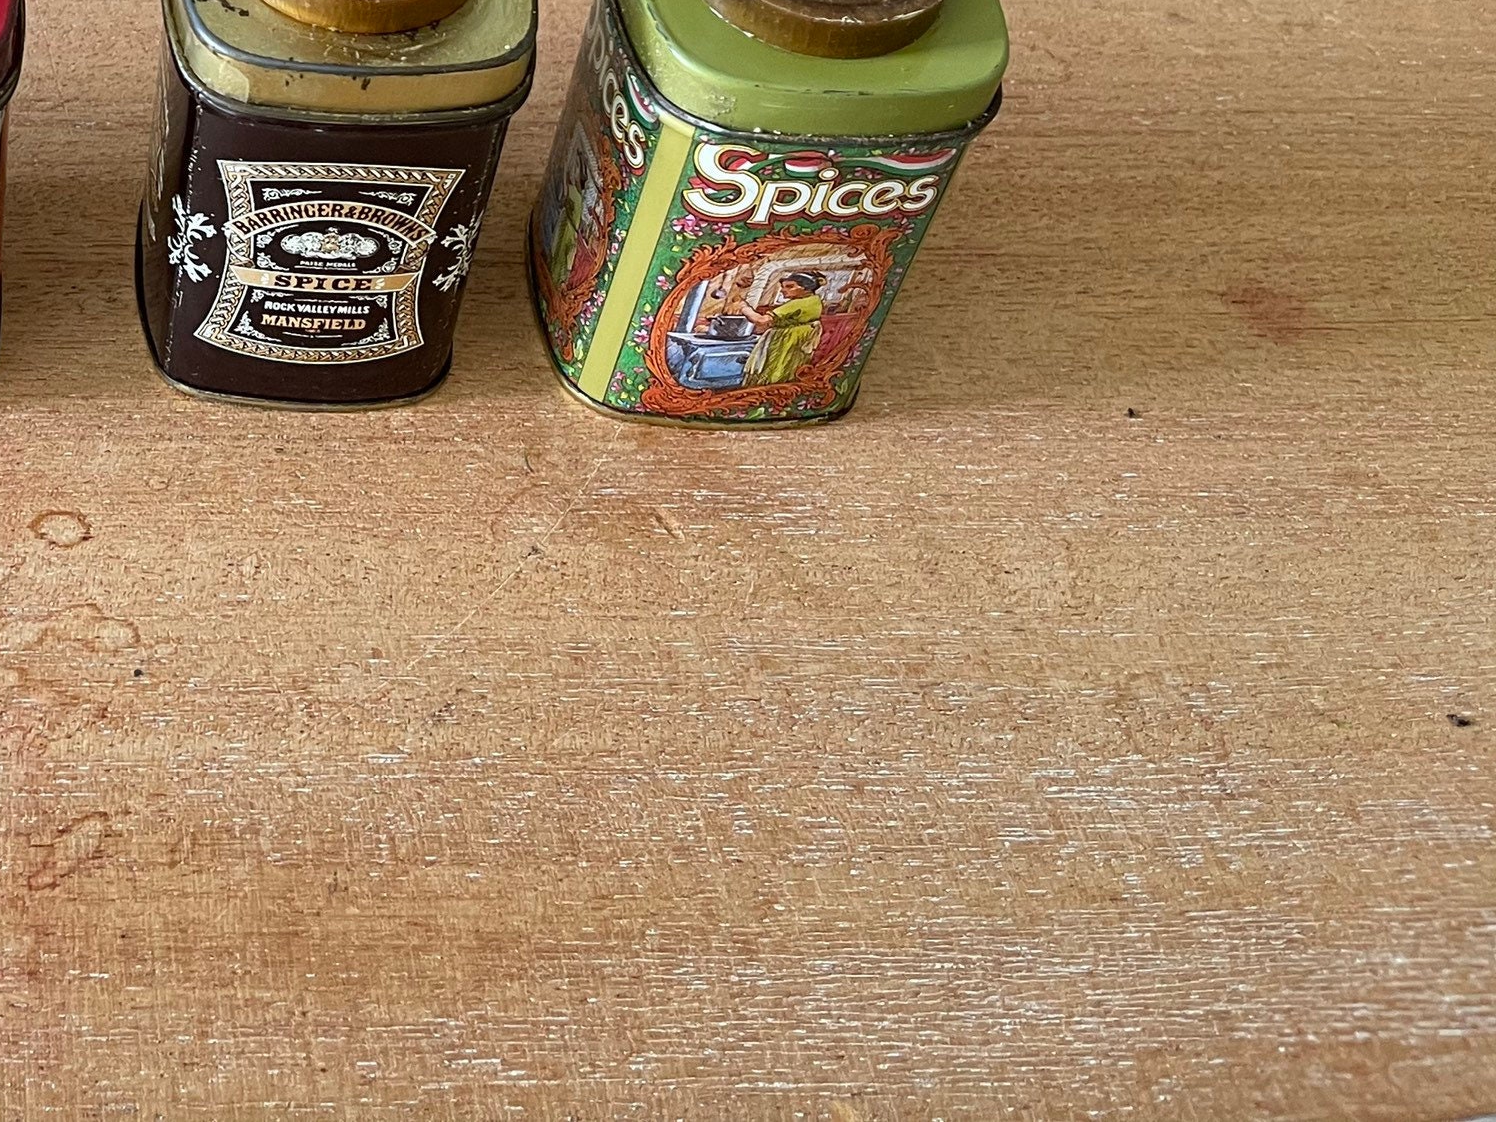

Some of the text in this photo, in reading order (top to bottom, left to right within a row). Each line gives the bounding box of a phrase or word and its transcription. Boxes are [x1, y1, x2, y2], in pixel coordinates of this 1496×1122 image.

[681, 141, 940, 225] Spices
[273, 274, 373, 291] SPICE
[264, 300, 370, 315] ROCK VALLEY MILLS
[260, 313, 367, 330] MANSFIELD
